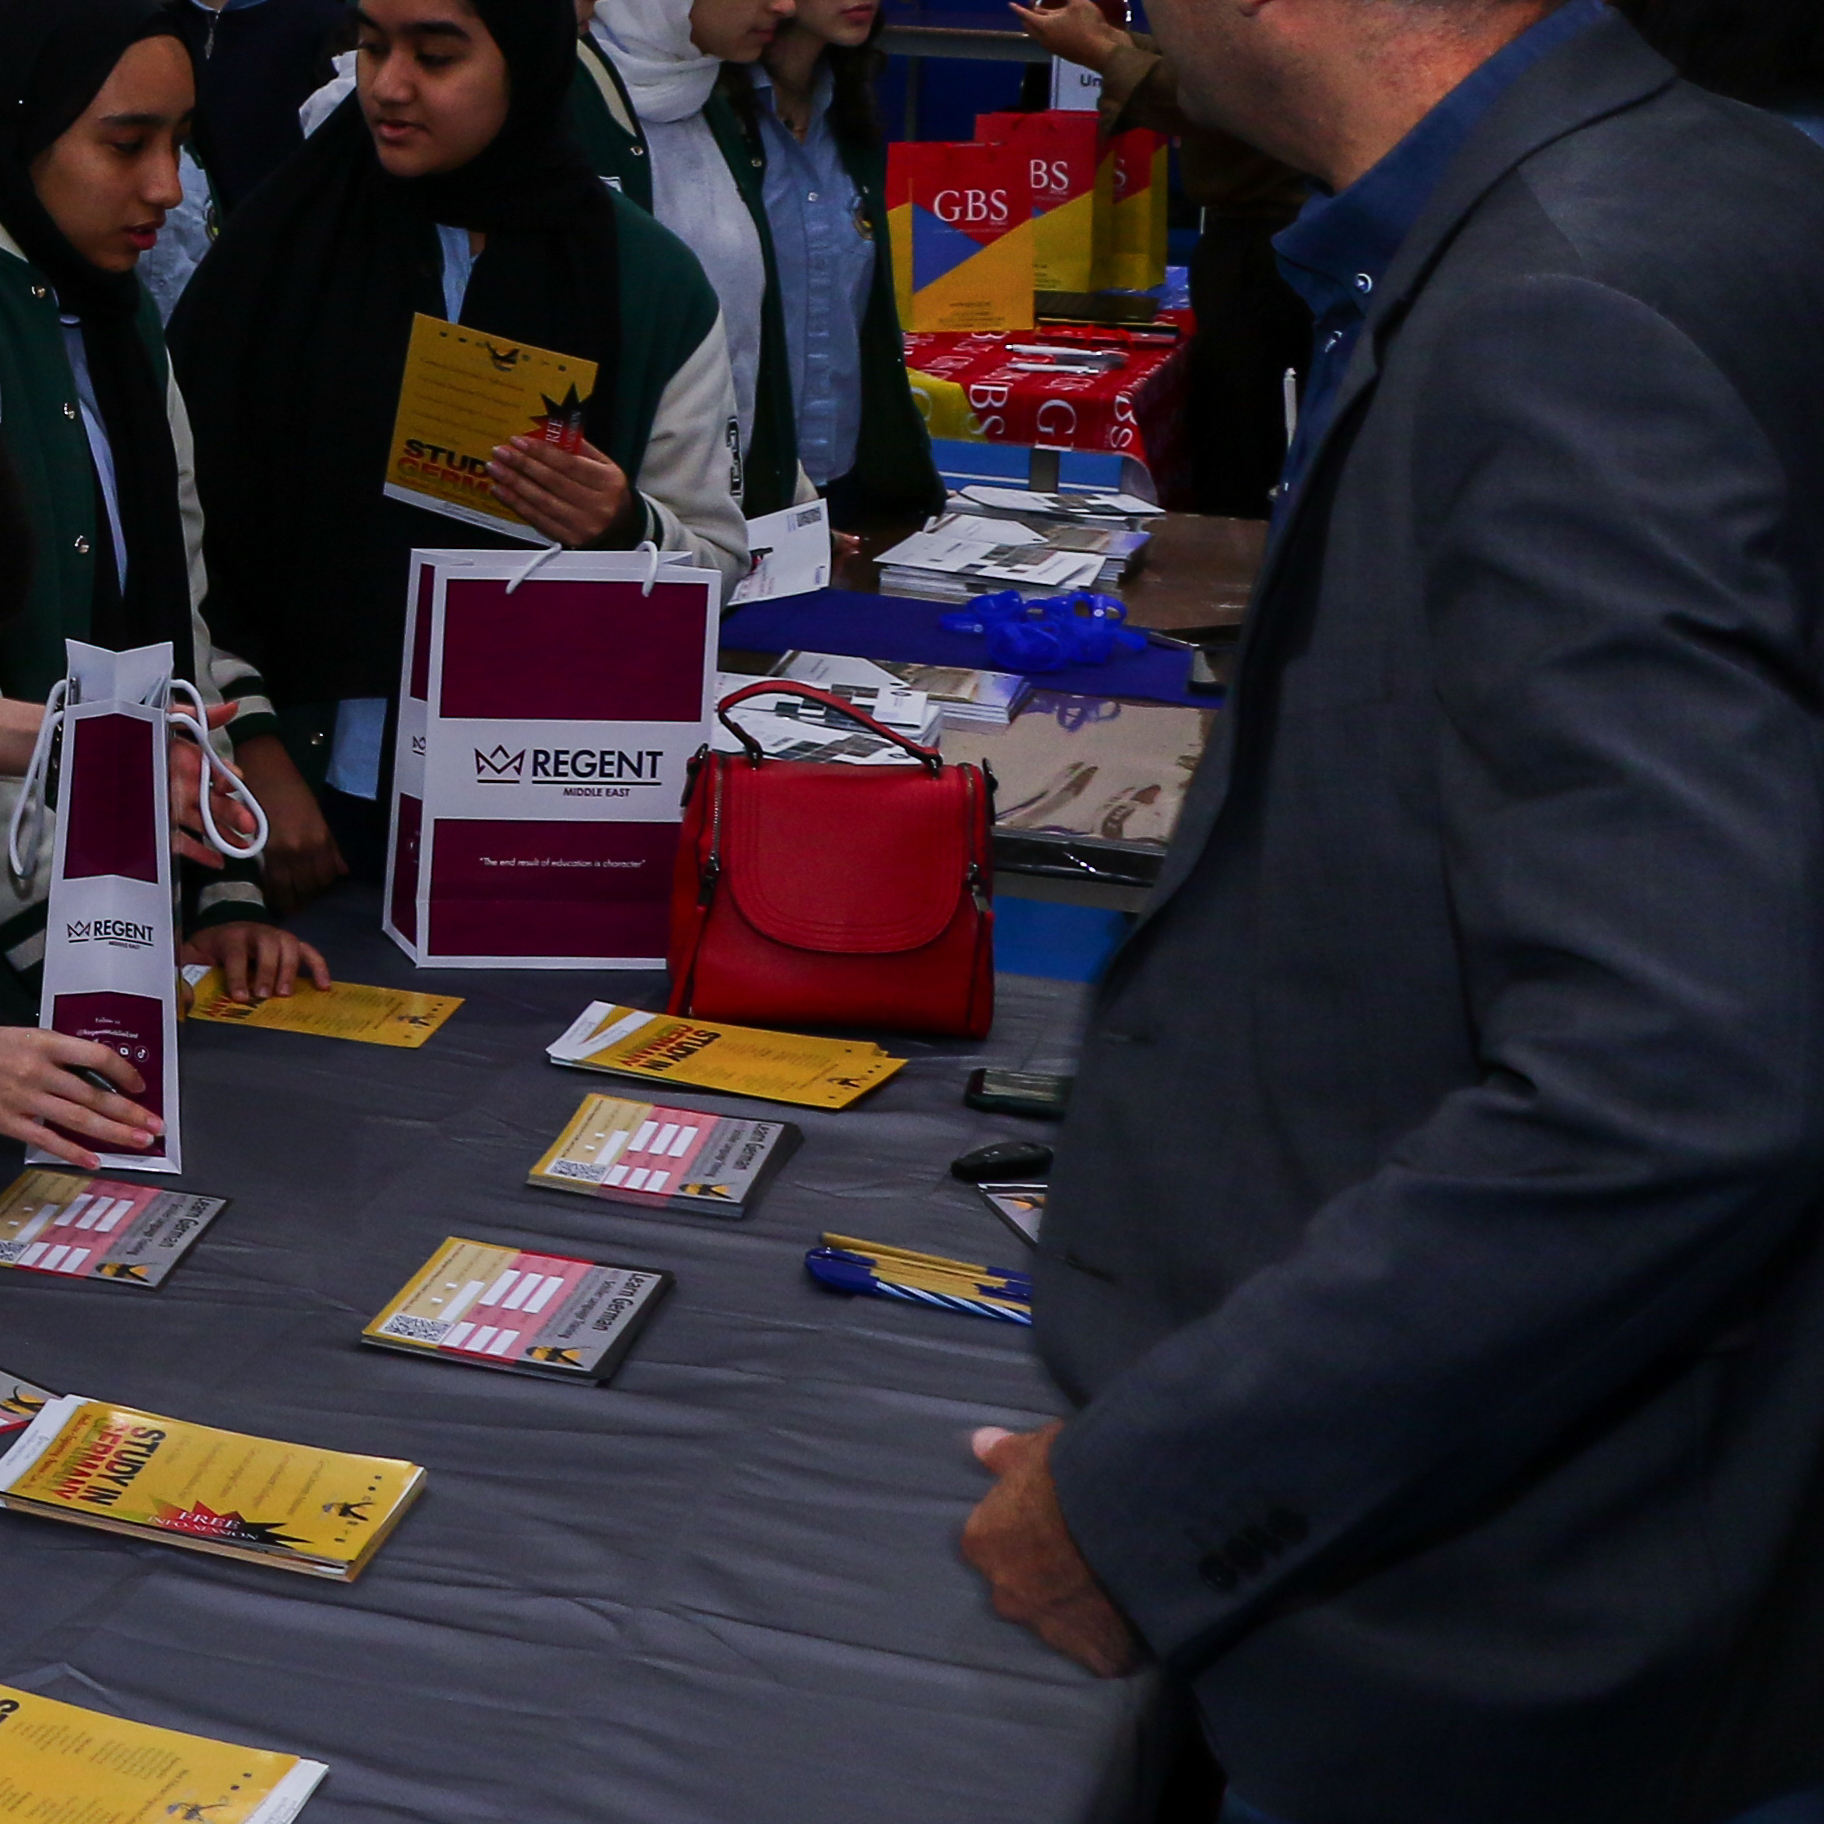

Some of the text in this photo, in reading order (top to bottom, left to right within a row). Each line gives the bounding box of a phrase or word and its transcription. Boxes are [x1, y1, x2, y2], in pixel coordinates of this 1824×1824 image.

[1029, 158, 1070, 191] BS
[933, 188, 1009, 223] GBS
[545, 417, 564, 444] REE
[404, 439, 489, 478] STUD
[398, 456, 491, 499] GERM
[532, 749, 663, 778] REGENT
[563, 787, 631, 797] MIDDLE EAST
[94, 919, 154, 942] REGENT
[639, 1029, 722, 1072] STUDY IN
[159, 1197, 218, 1249] Learn German
[592, 1273, 653, 1332] Learn German
[52, 1417, 131, 1501] GERMANY
[79, 1425, 167, 1507] STUDY IN
[177, 1509, 242, 1531] FREE
